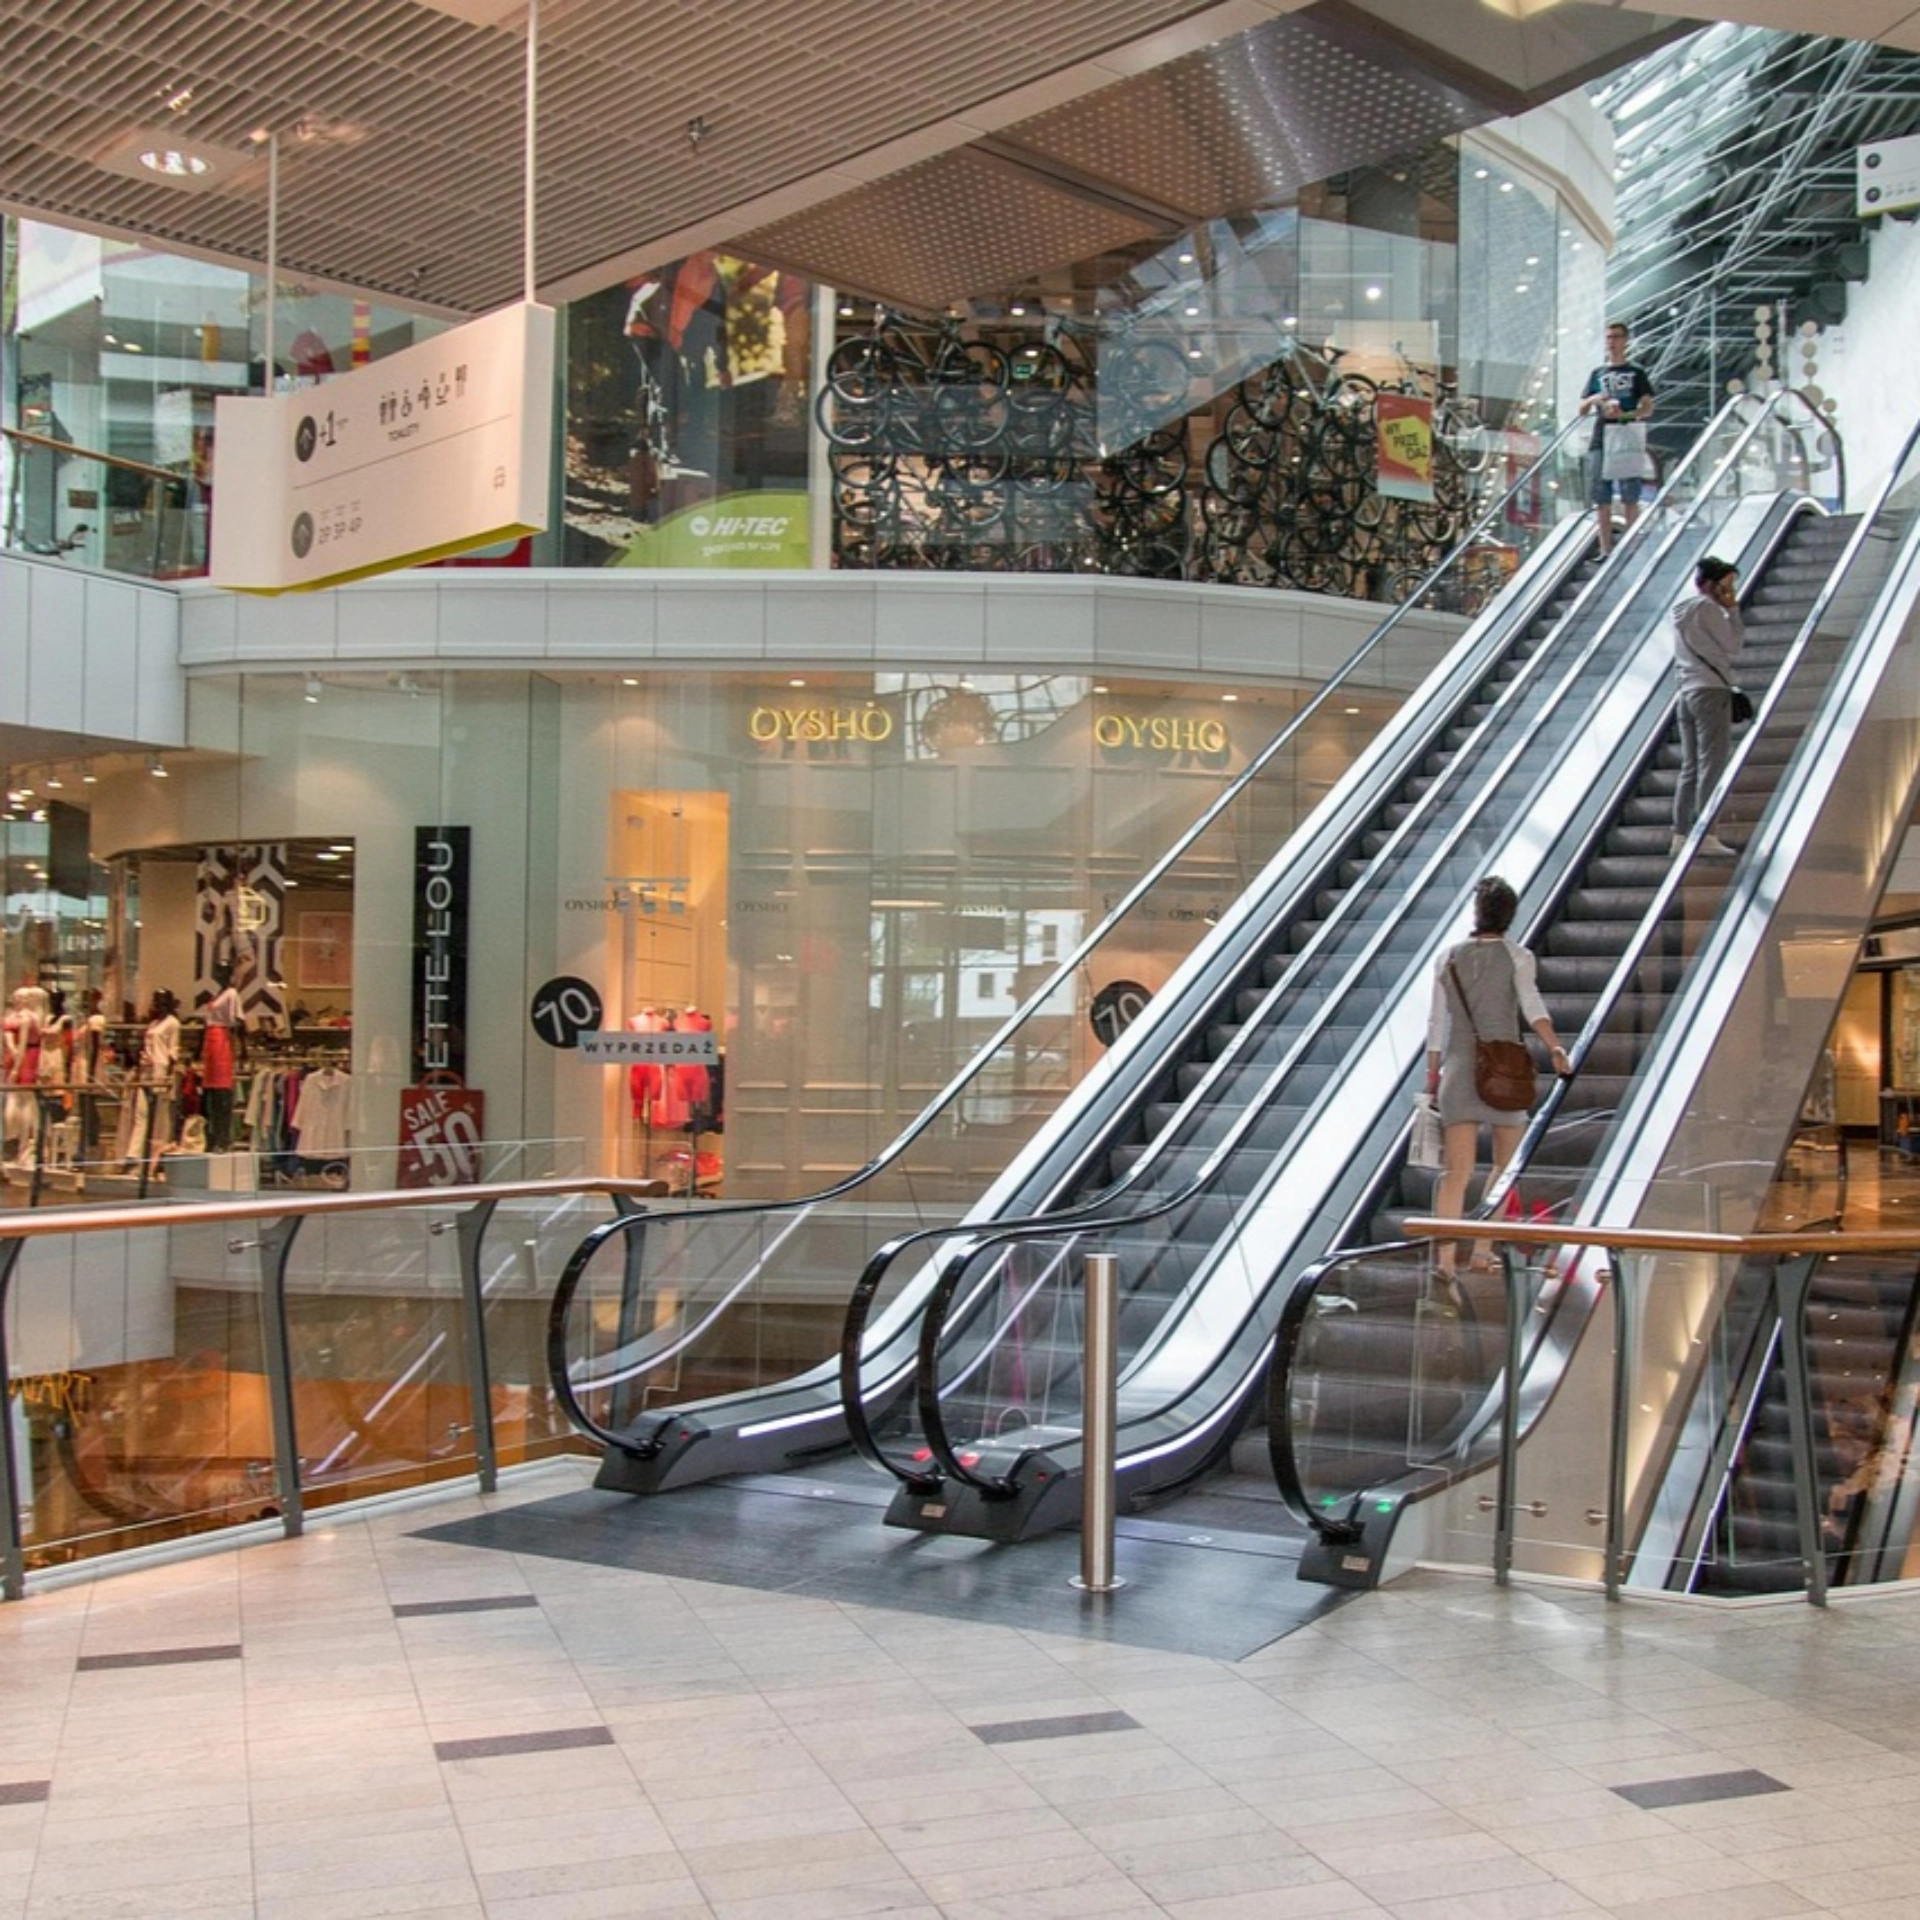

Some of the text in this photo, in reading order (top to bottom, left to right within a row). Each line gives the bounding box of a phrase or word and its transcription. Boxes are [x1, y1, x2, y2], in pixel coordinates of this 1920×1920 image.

[711, 516, 789, 536] HI-TEC
[748, 705, 893, 743] OYSHO
[1094, 714, 1226, 753] OYSHO
[424, 841, 454, 1068] ETTE LOU
[583, 1040, 713, 1055] WYPRZEDAŻ
[403, 1091, 452, 1131] SALE
